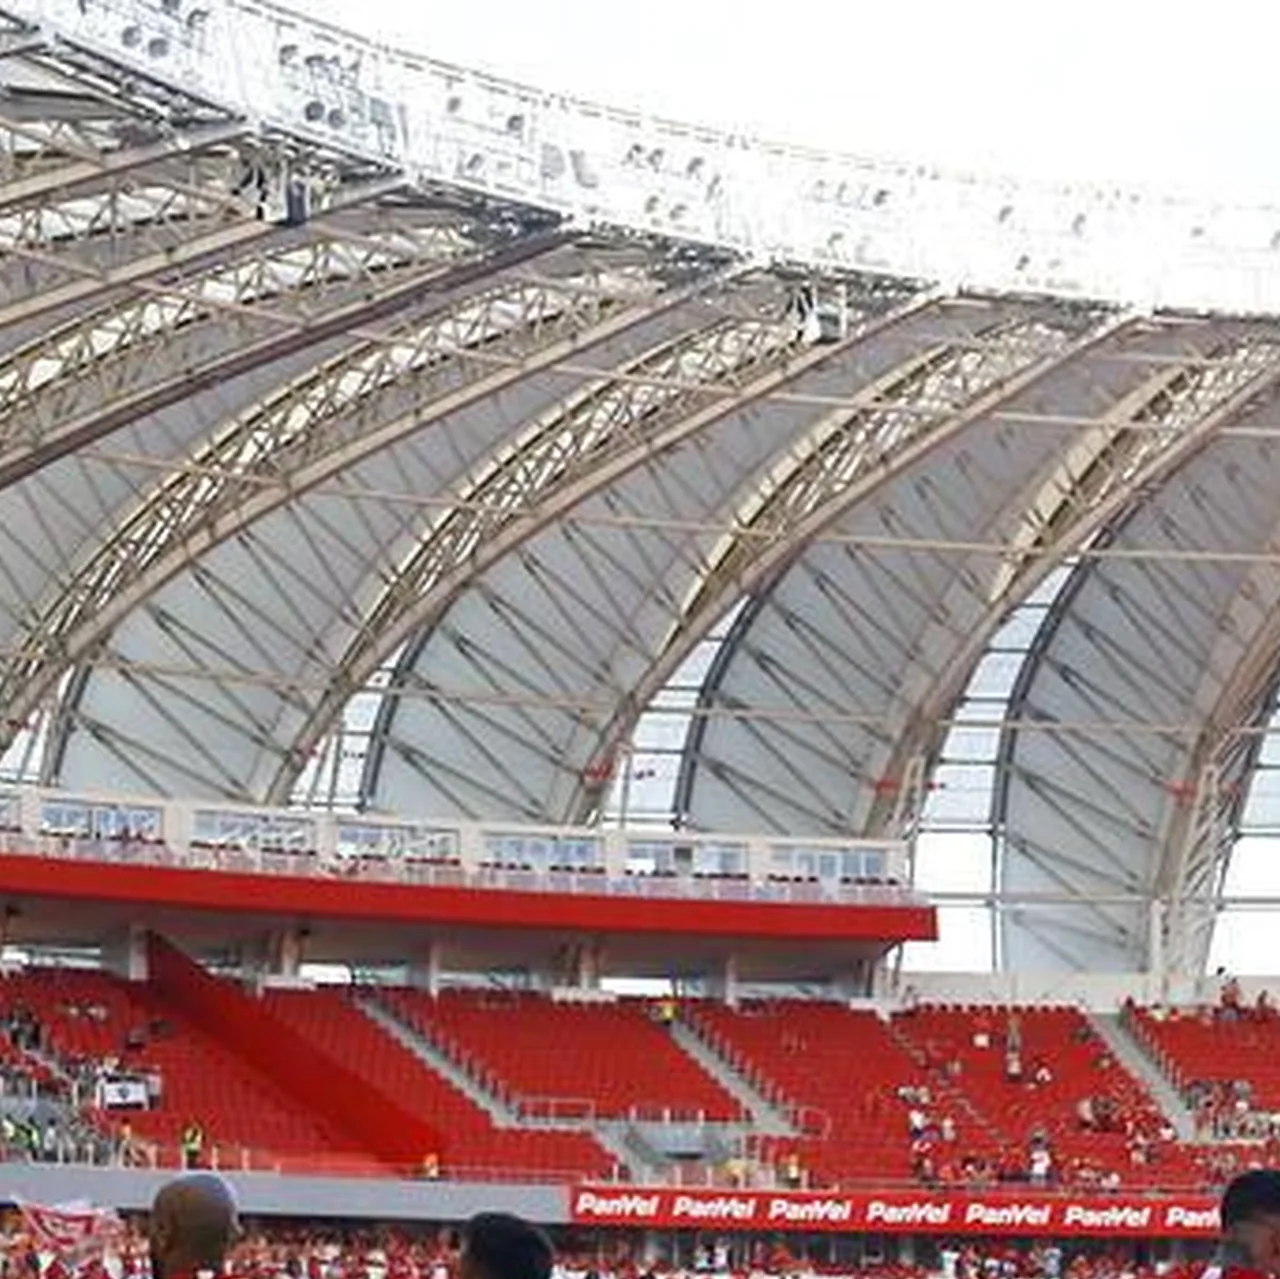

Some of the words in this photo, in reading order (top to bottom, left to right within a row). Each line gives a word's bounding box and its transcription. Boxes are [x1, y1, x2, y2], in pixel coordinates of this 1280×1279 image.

[576, 1193, 658, 1216] PanVel
[672, 1195, 755, 1220] PanVel
[768, 1199, 851, 1222] PanVel
[867, 1201, 951, 1224] PanVel
[966, 1204, 1051, 1226] PanVel
[1063, 1206, 1151, 1228] PanVel
